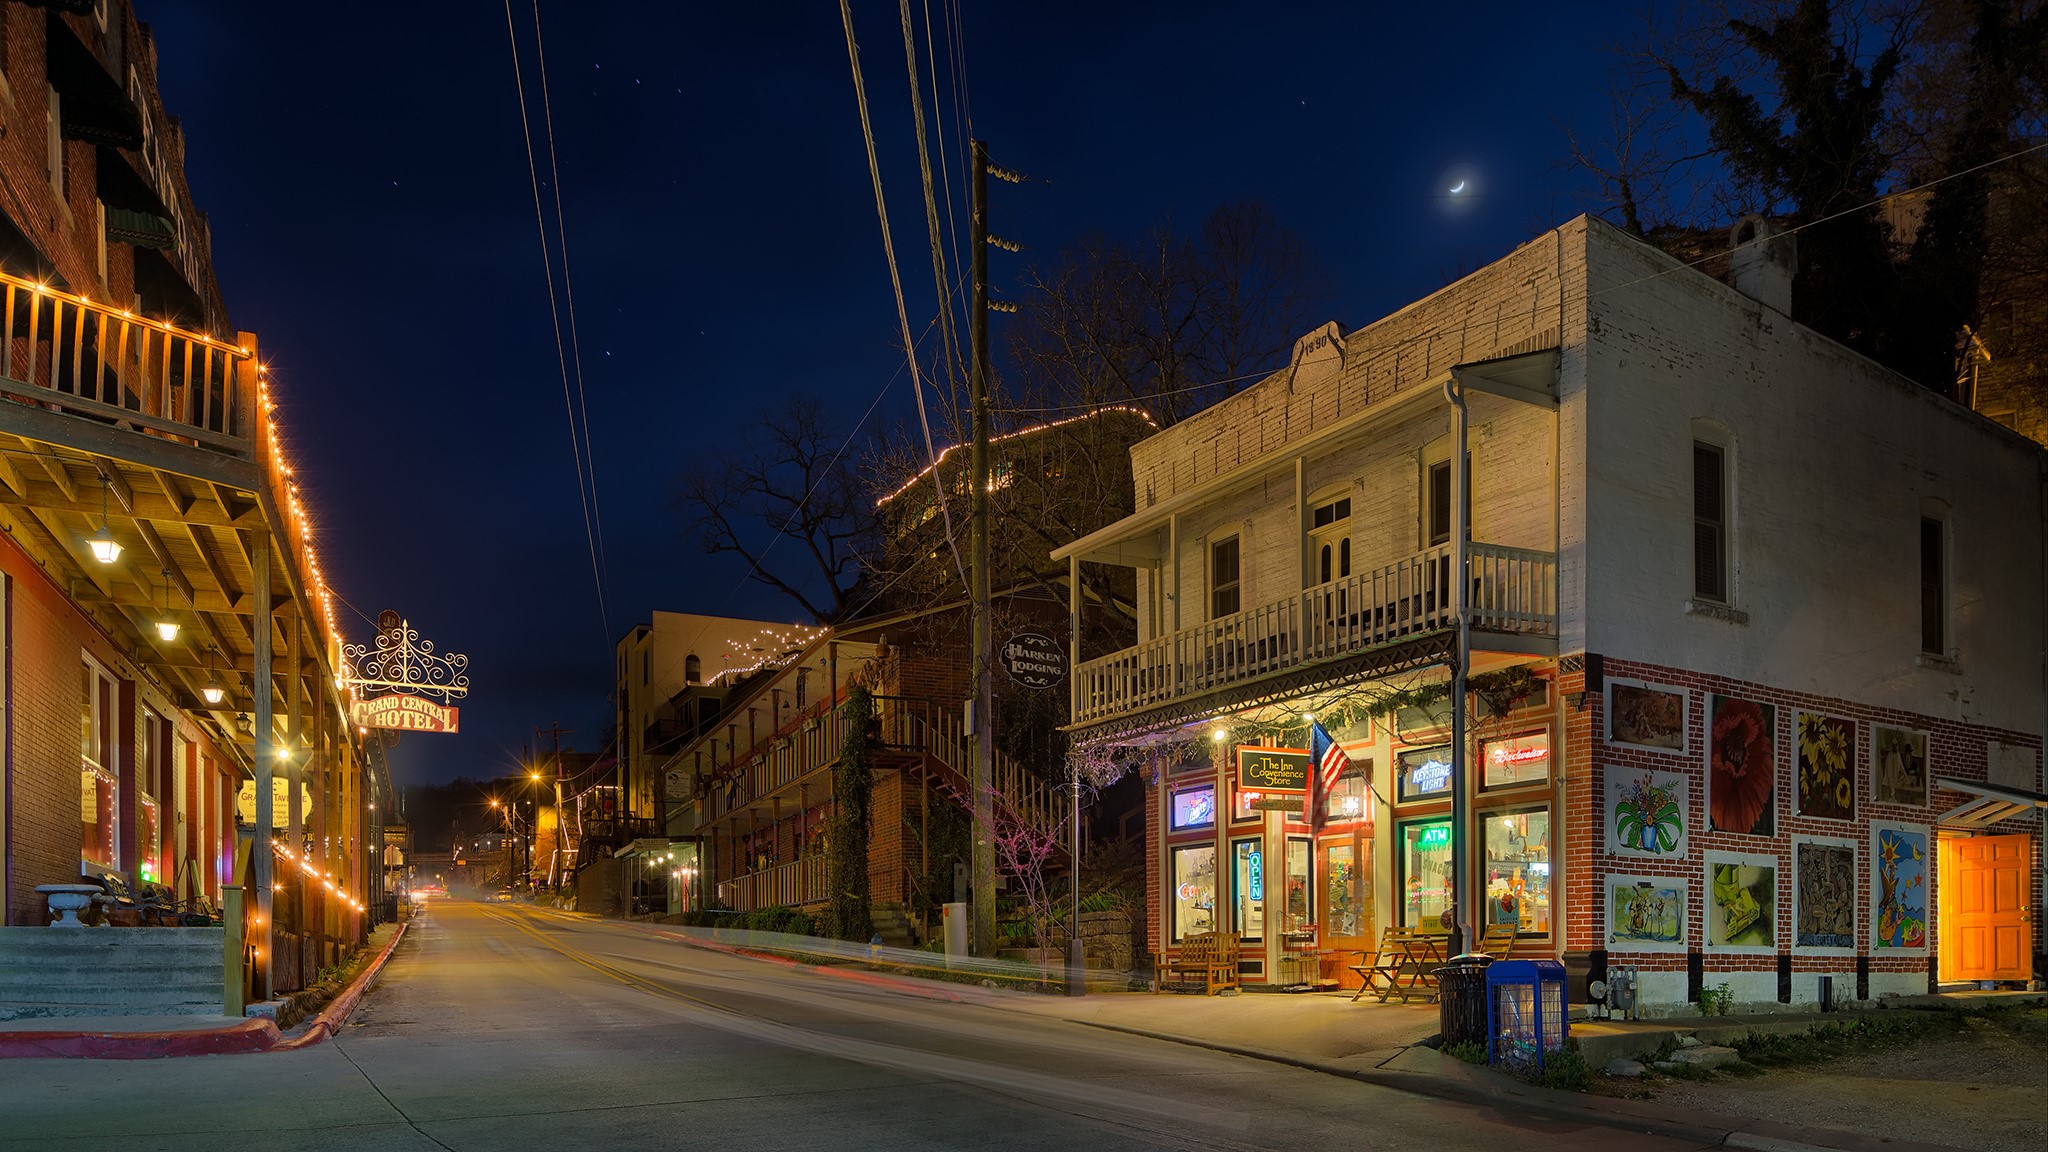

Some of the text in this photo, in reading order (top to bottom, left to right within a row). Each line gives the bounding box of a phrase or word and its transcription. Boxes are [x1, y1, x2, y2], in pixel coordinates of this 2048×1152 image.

[1306, 335, 1327, 357] 1890
[1005, 643, 1061, 663] HARKEN
[1011, 660, 1061, 675] LODGING
[353, 696, 457, 733] GRAND CENTRAL
[375, 709, 436, 730] HOTEL
[1249, 763, 1304, 779] Convenience
[1260, 757, 1294, 772] The Inn
[1264, 776, 1291, 786] Store
[1412, 765, 1451, 783] KEYSTONE
[1424, 829, 1447, 842] ATM
[1250, 854, 1262, 898] OPEN
